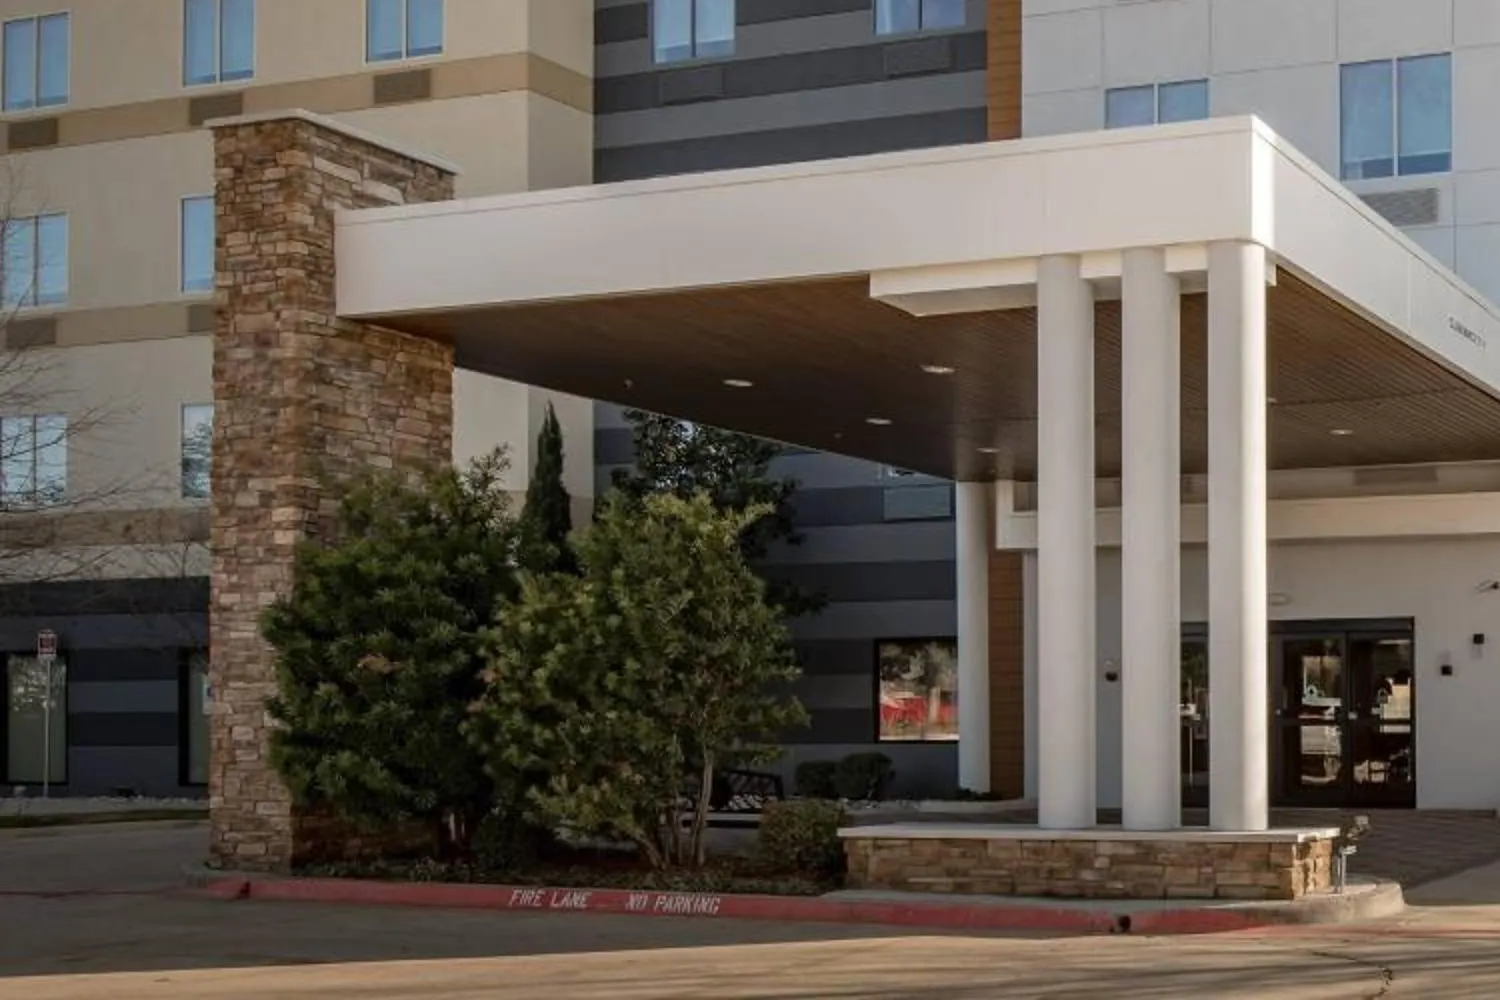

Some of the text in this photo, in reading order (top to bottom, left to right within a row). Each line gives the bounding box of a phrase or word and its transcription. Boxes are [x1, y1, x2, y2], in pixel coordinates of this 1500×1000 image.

[508, 889, 721, 914] FIRE LANE NO PARKING
